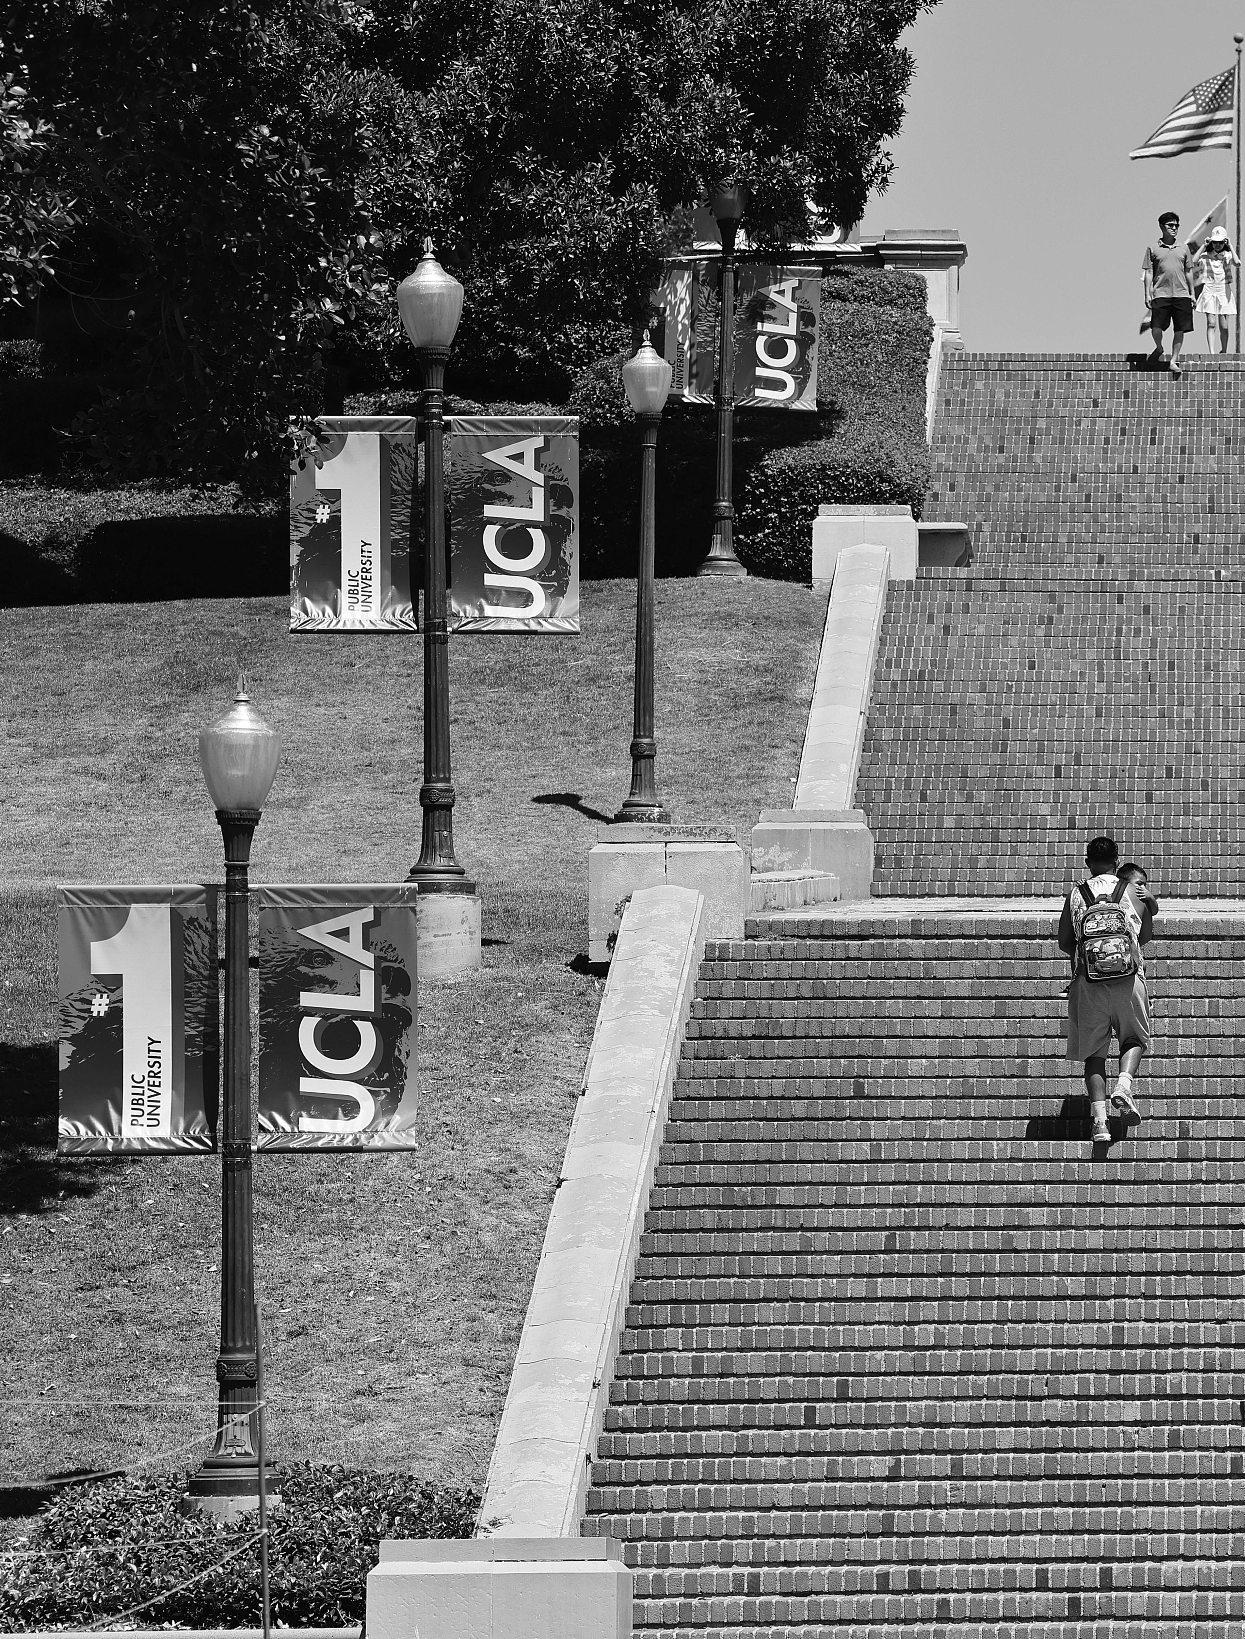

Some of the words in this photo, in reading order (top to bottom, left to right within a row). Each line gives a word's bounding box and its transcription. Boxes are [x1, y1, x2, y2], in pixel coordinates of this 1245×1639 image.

[676, 341, 686, 390] UNIVERSITY
[755, 279, 799, 400] UCLA
[482, 435, 546, 618] UCLA
[347, 569, 360, 612] PUBLIC
[360, 540, 373, 613] UNIVERSITY
[90, 903, 171, 1137] #1
[297, 905, 377, 1132] UCLA
[131, 1074, 145, 1127] PUBLIC
[146, 1036, 162, 1128] UNIVERSITY
